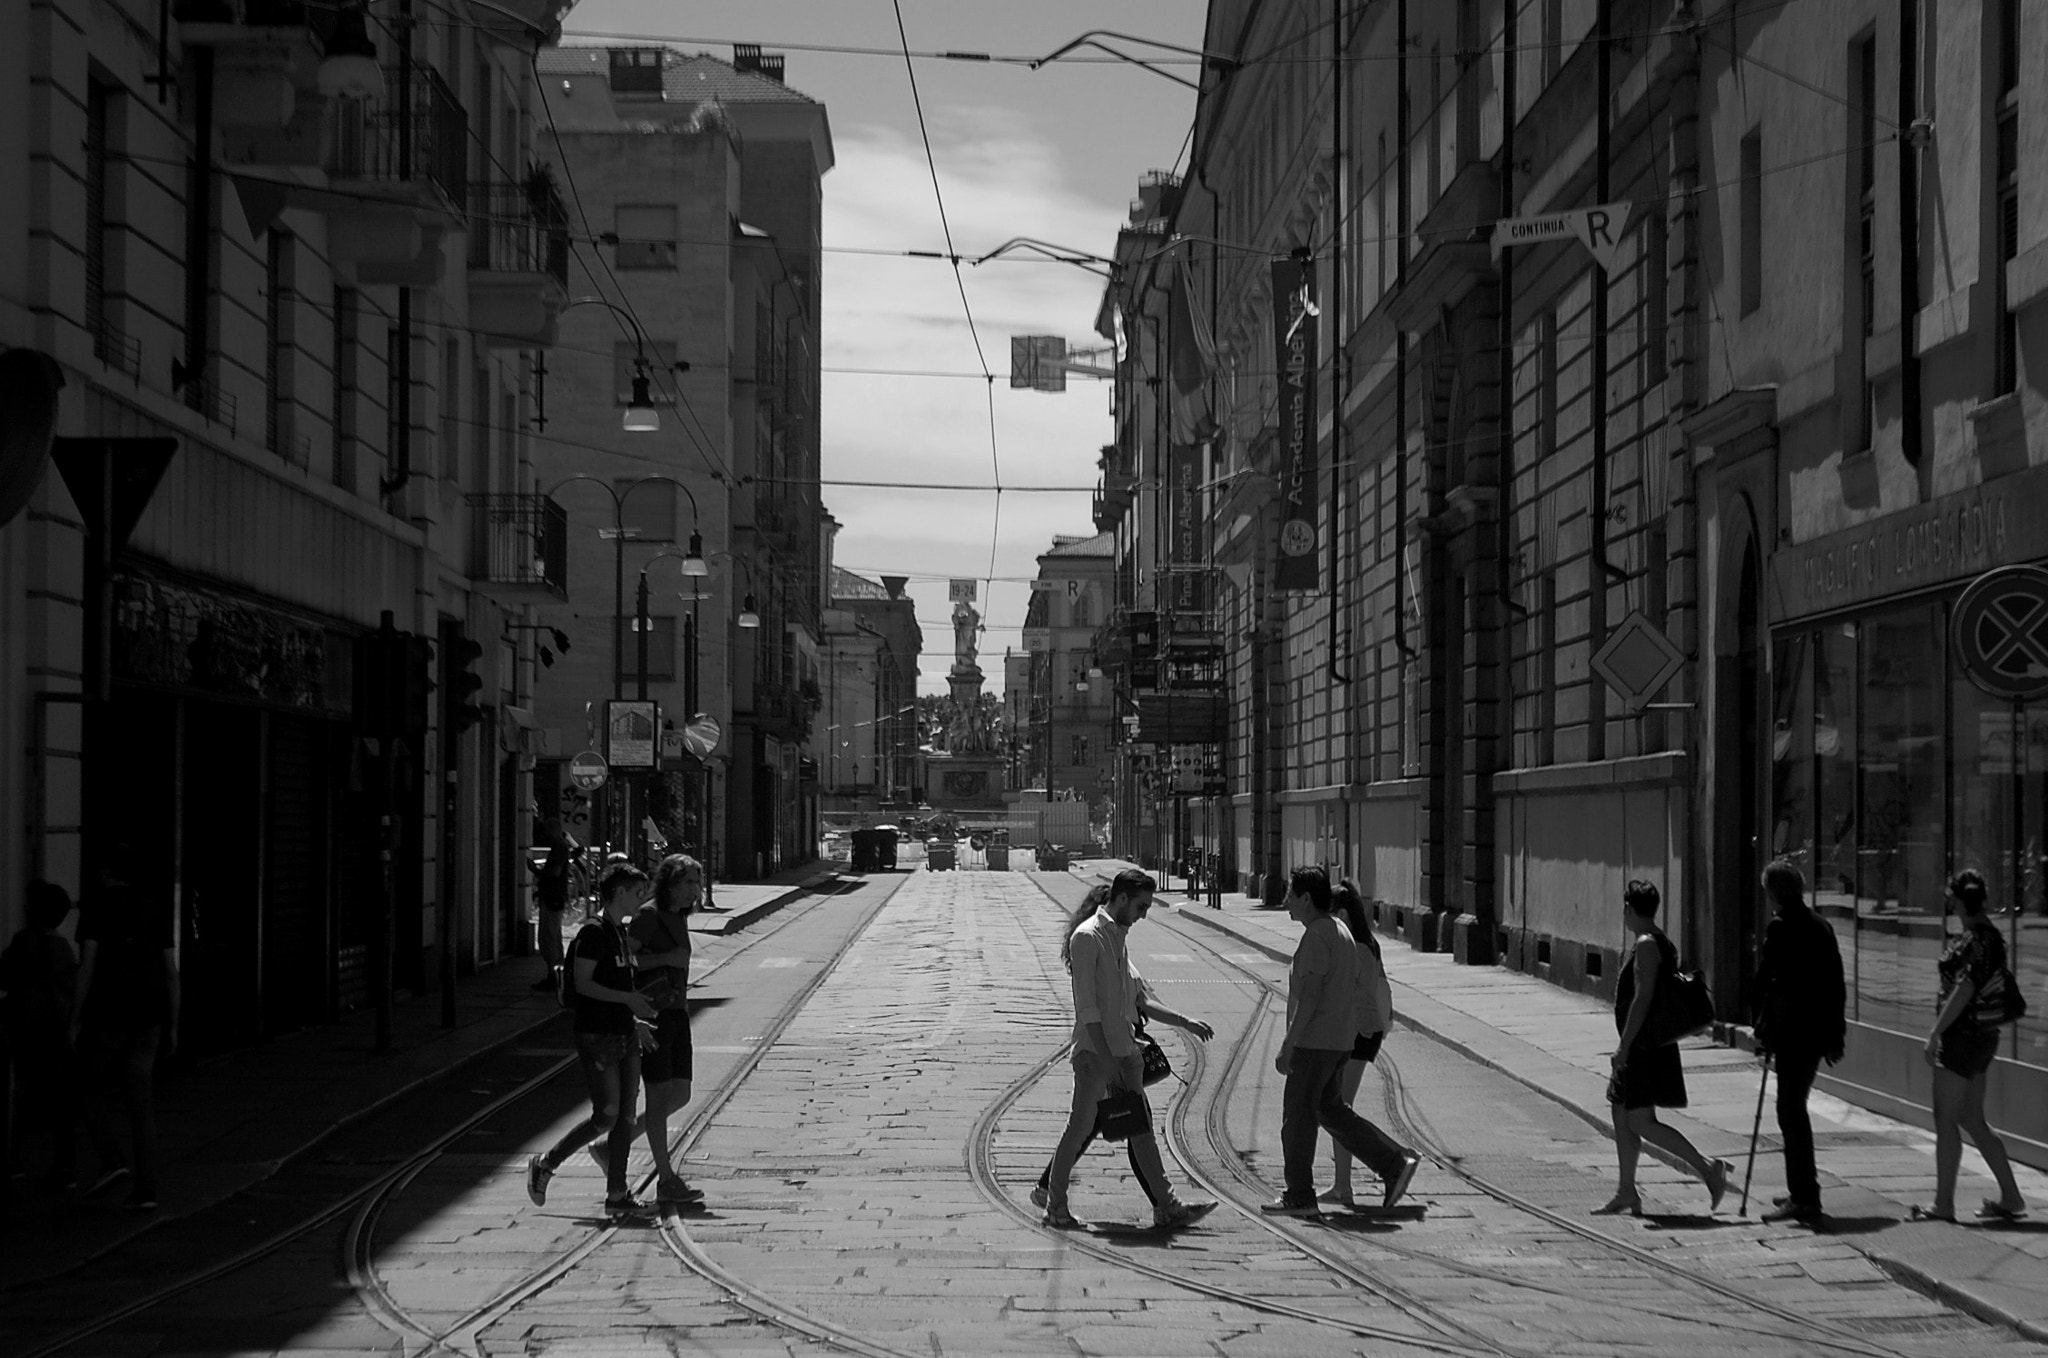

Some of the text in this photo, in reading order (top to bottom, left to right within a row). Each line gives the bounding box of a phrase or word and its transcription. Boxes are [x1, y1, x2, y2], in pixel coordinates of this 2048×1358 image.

[1511, 210, 1612, 248] CONTINUA R
[1287, 394, 1304, 506] Accademia
[1895, 495, 2006, 575] LOMBARDIA
[951, 585, 974, 597] 19-24
[1067, 580, 1079, 597] R
